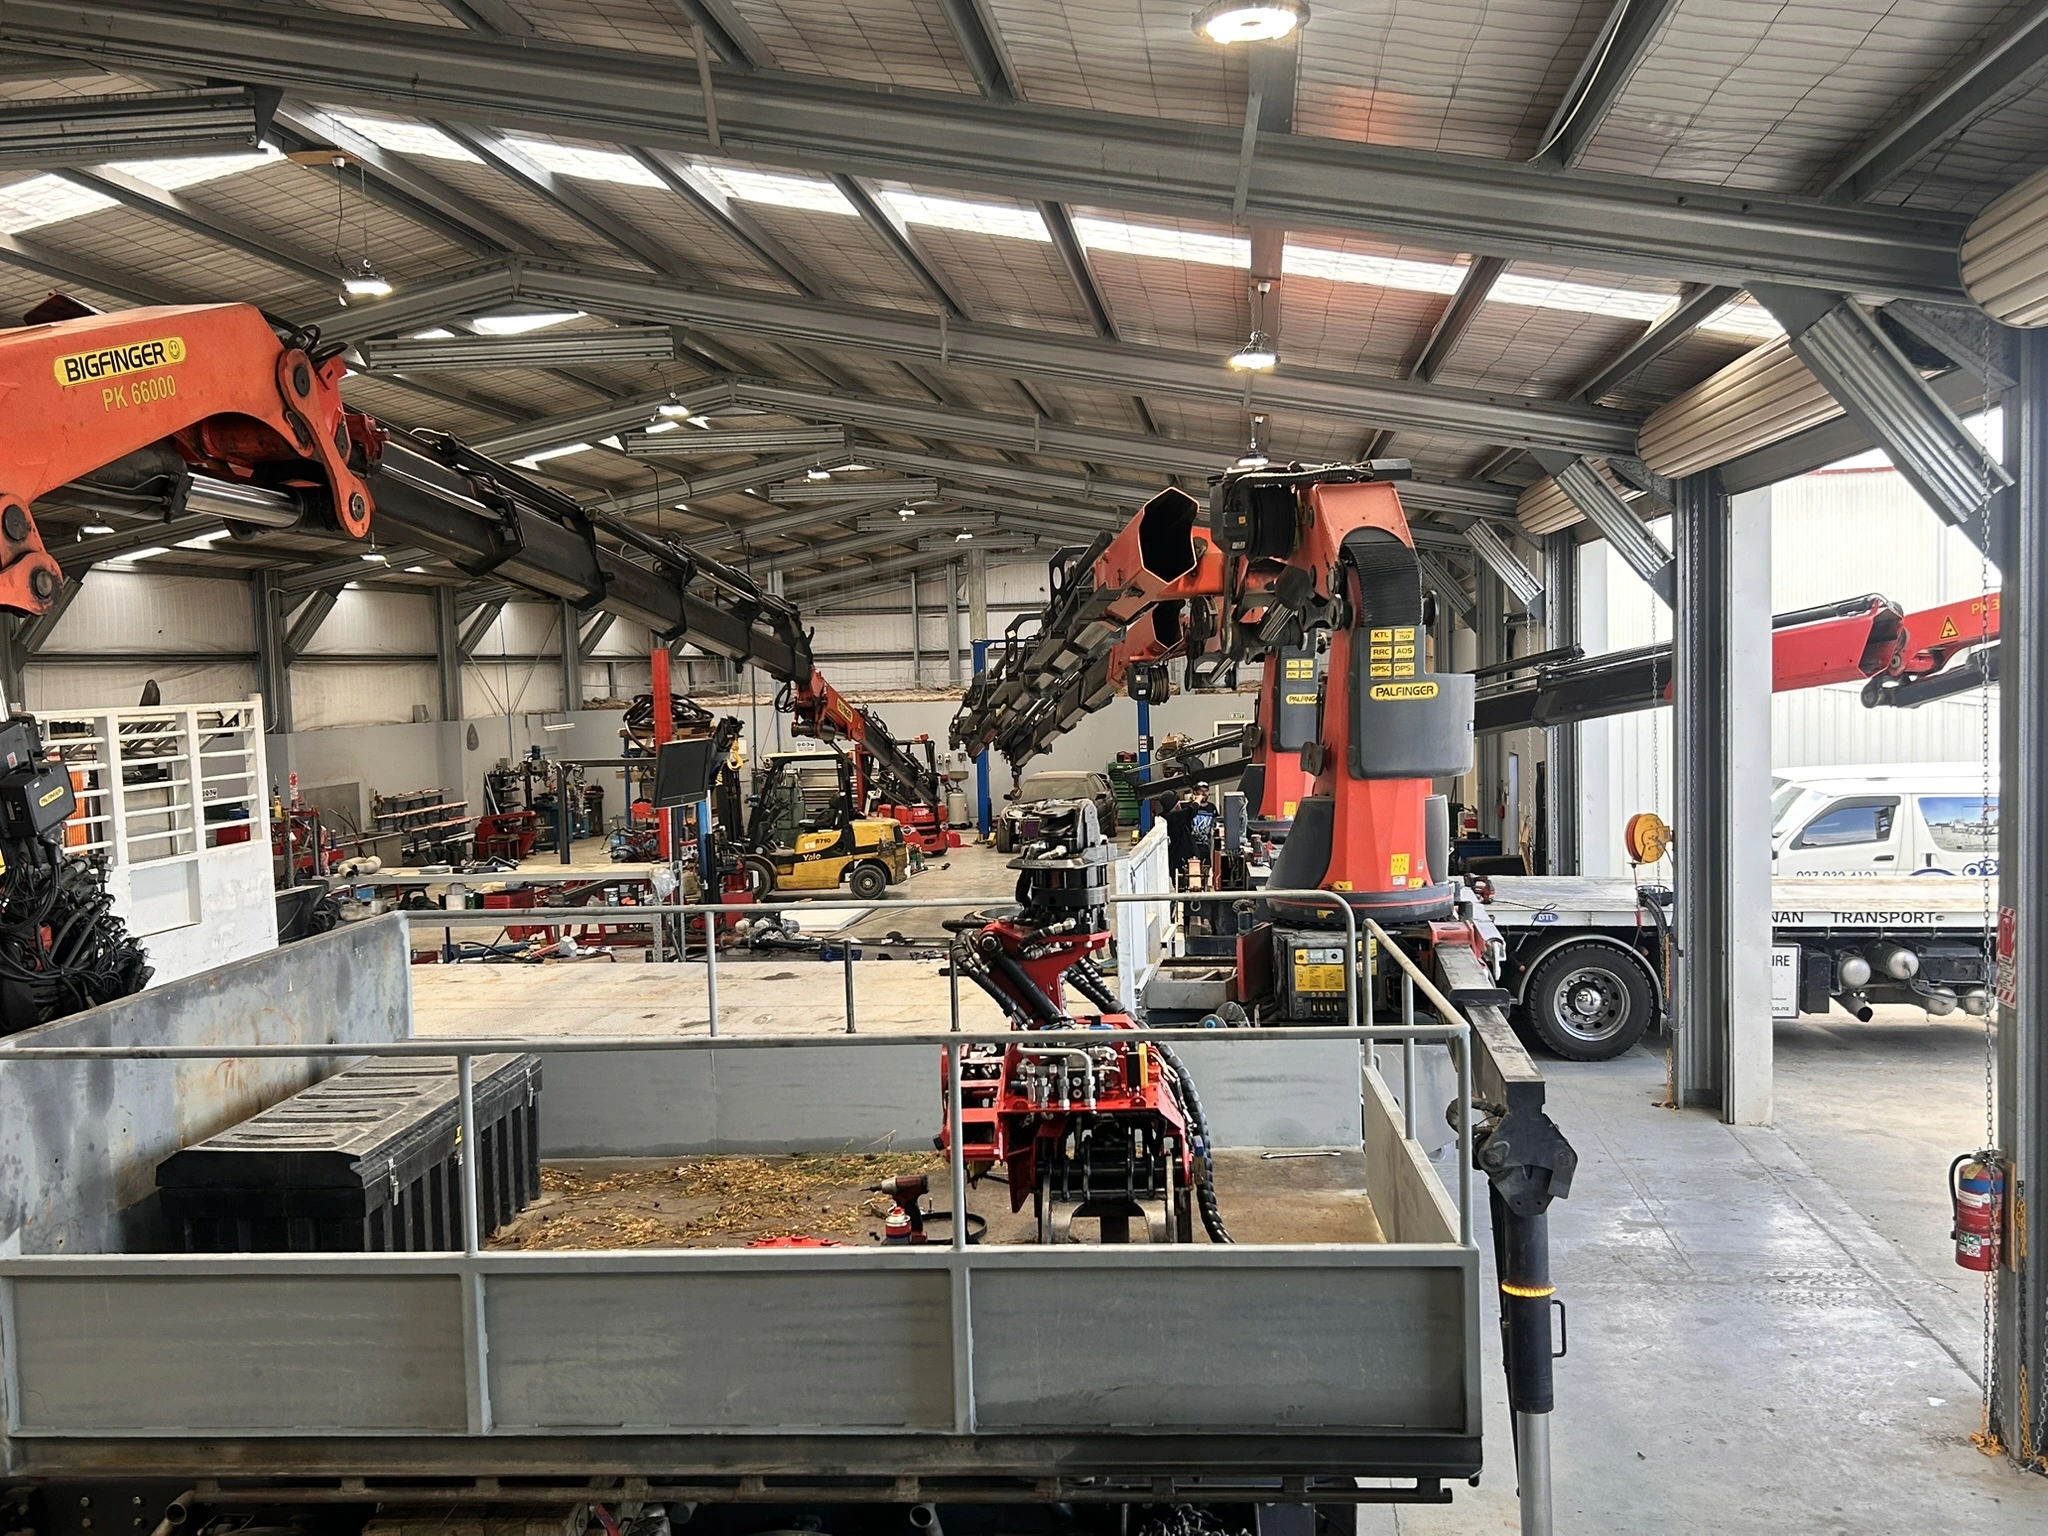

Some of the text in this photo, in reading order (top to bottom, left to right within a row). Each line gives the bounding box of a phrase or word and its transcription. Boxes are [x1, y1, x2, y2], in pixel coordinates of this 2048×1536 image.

[64, 342, 166, 382] BIGFINGER
[102, 375, 176, 412] PK 66000
[1375, 685, 1434, 697] PALFINGER
[1831, 911, 1936, 924] TRANSPORT
